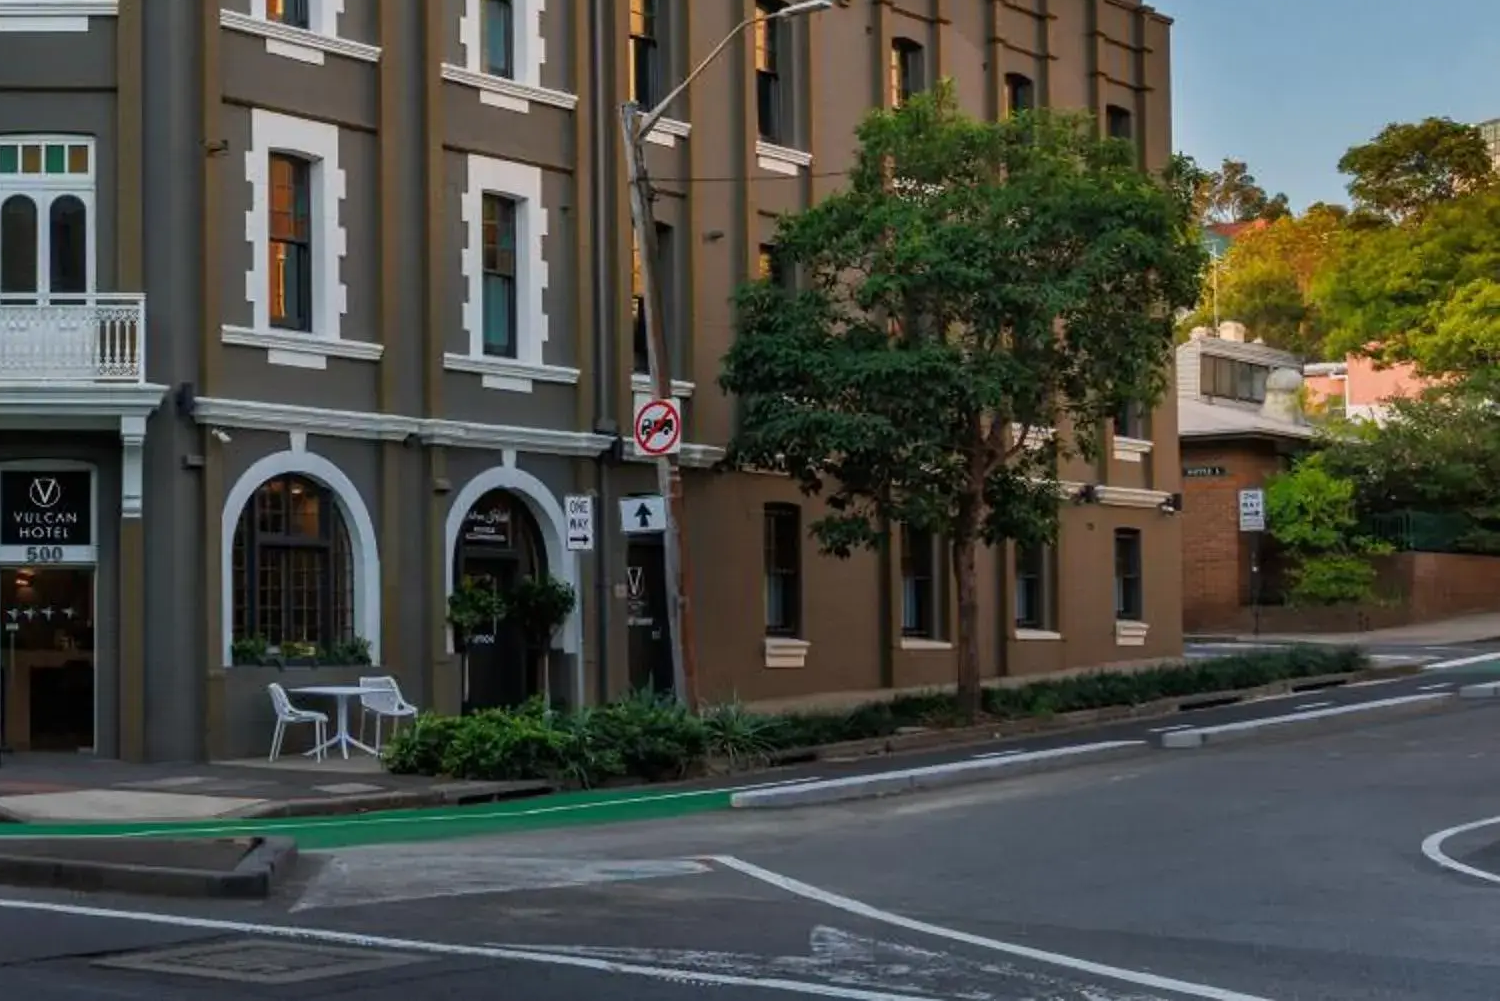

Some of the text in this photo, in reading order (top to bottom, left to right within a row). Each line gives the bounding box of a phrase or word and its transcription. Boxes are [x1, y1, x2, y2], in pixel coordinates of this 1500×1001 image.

[570, 500, 589, 514] ONE
[13, 511, 77, 524] VULCAN
[570, 518, 589, 530] WAY
[19, 526, 69, 539] HOTEL
[27, 546, 64, 563] 500
